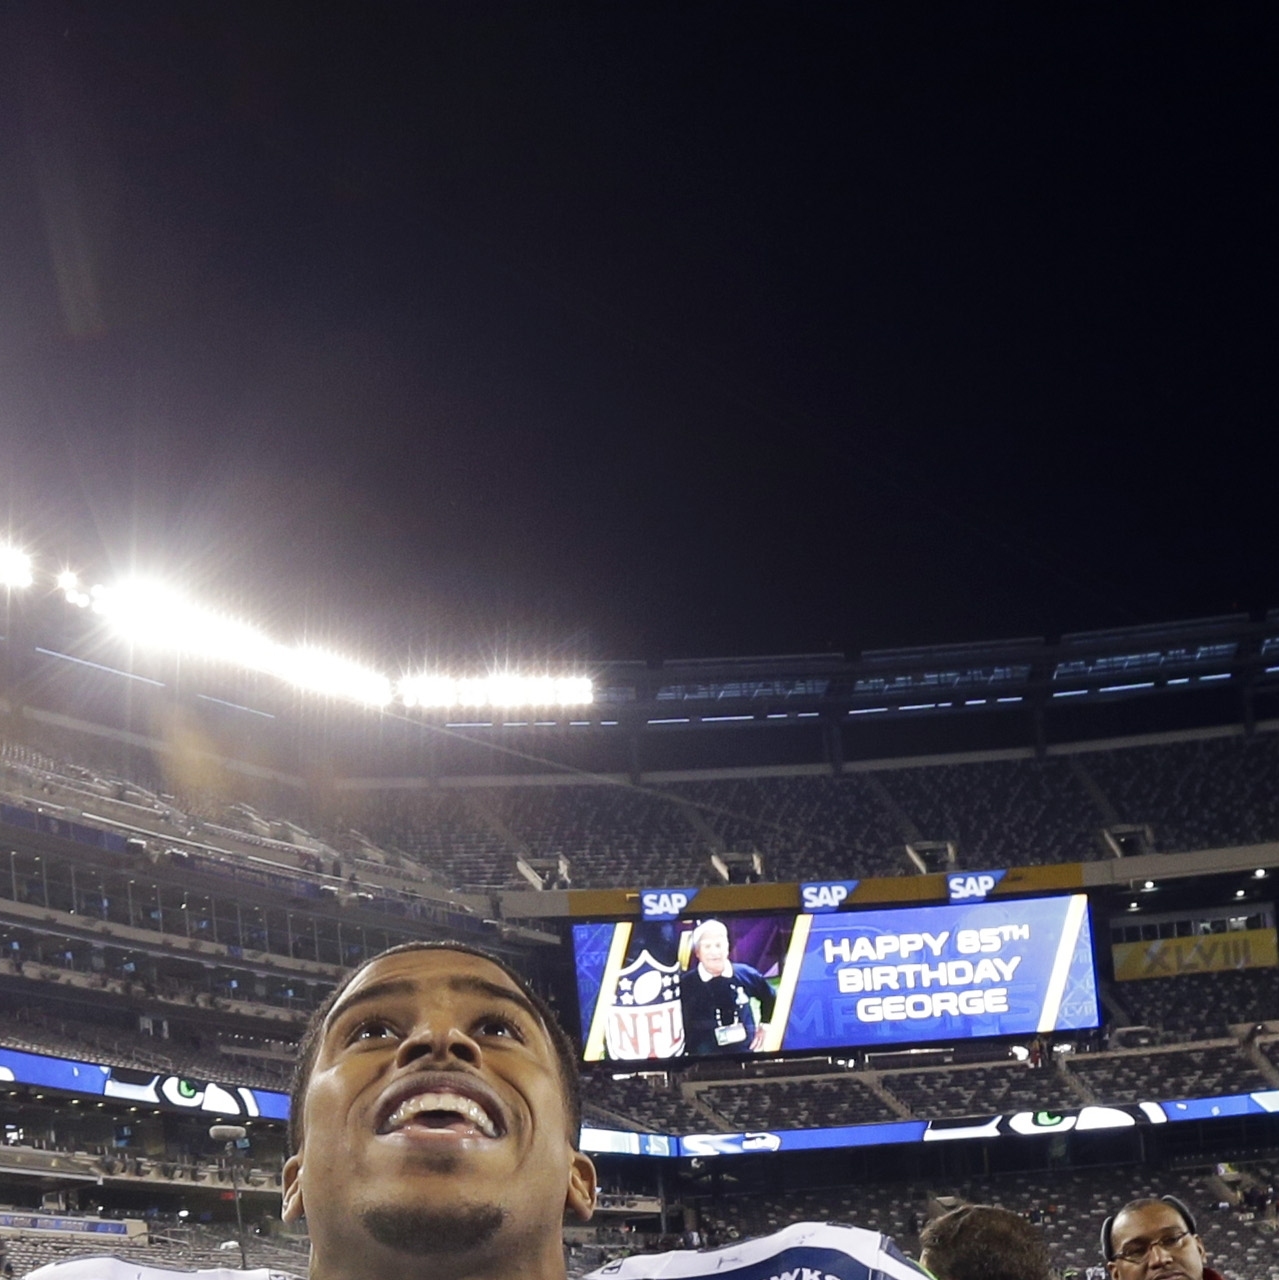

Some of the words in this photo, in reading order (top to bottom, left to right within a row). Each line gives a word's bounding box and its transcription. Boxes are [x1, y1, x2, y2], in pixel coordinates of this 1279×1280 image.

[643, 893, 689, 916] SAP
[802, 885, 848, 908] SAP
[949, 875, 995, 899] SAP
[823, 930, 950, 964] HAPPY
[956, 923, 1030, 955] 85TH
[1143, 938, 1252, 974] XLVIII
[837, 955, 1022, 994] BIRTHDAY
[856, 987, 1010, 1023] GEORGE
[615, 1007, 682, 1058] NFL
